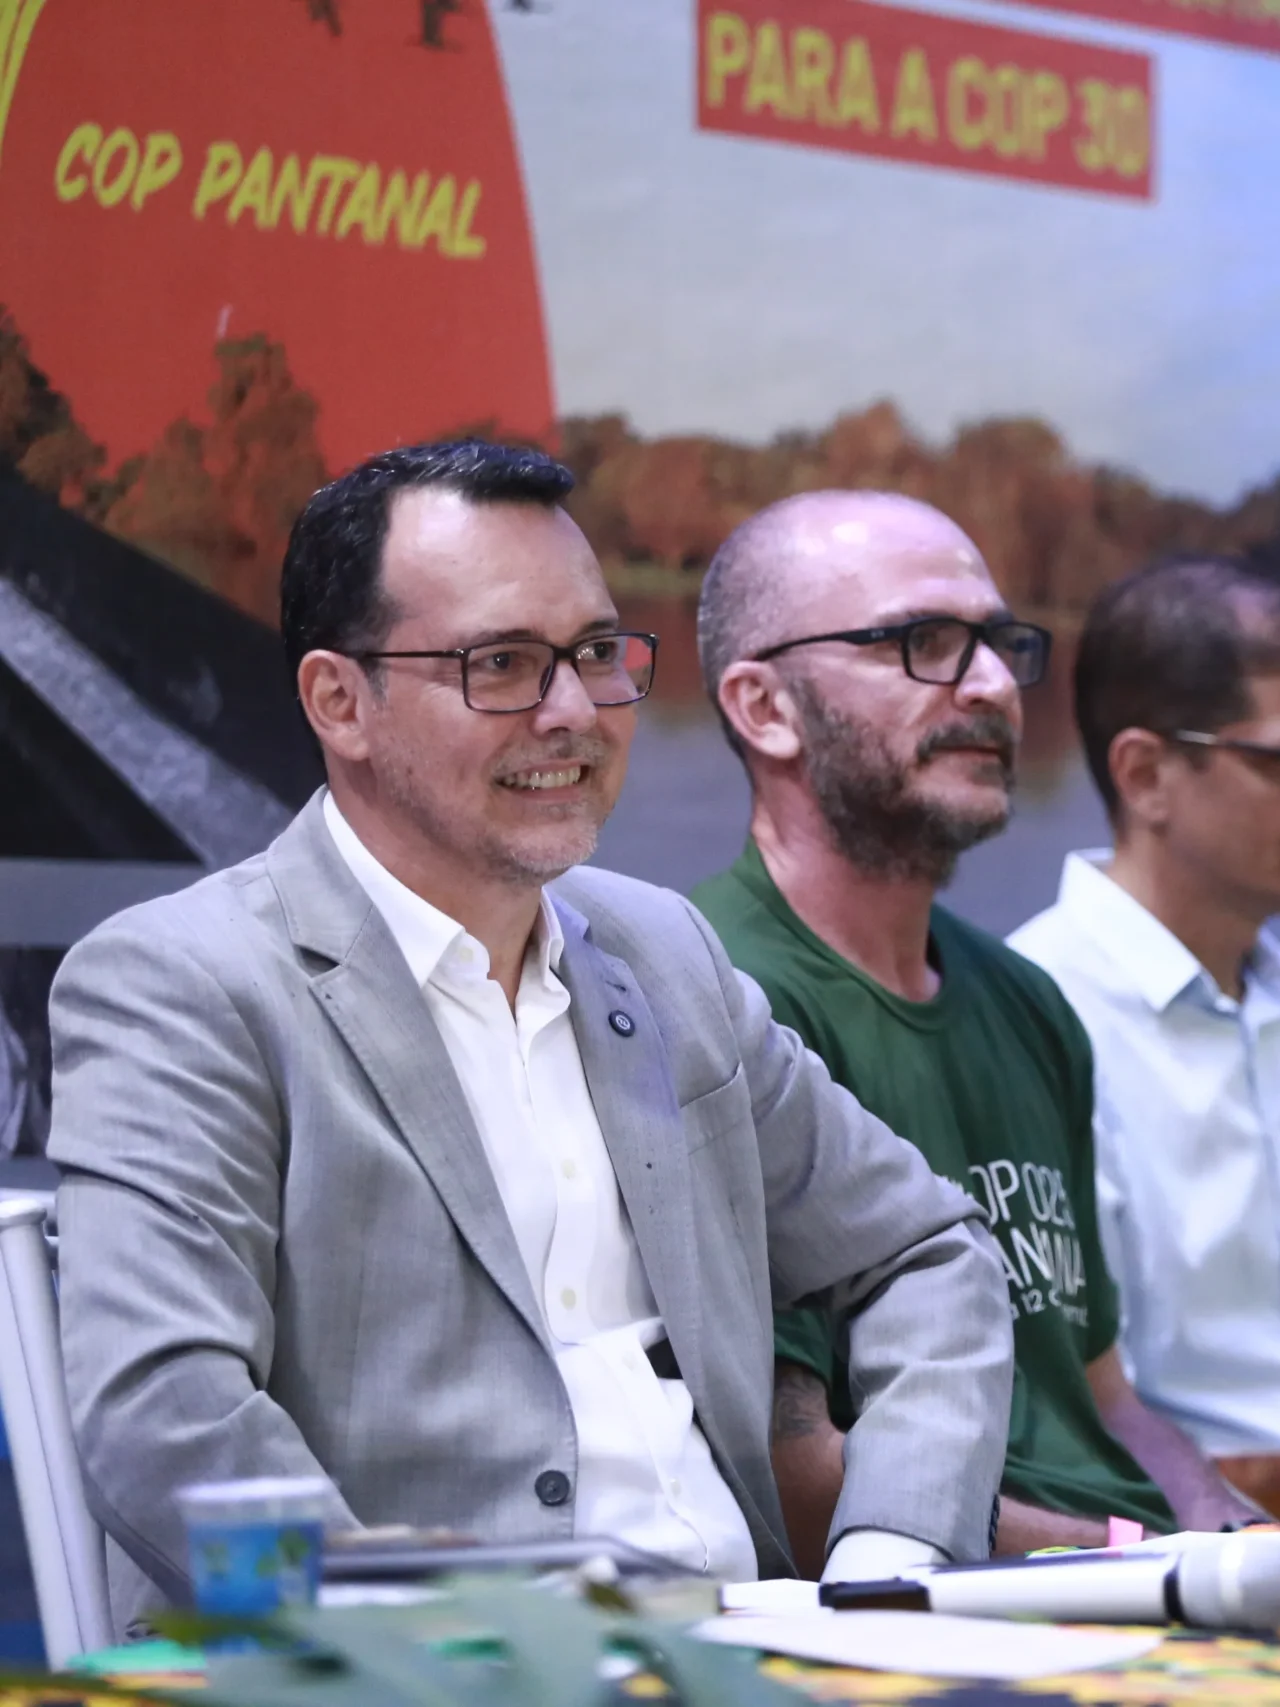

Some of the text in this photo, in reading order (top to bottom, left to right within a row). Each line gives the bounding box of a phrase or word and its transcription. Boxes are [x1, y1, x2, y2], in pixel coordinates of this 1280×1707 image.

[704, 12, 1151, 178] PARA A COP 30
[55, 122, 487, 258] COP PANTANAL
